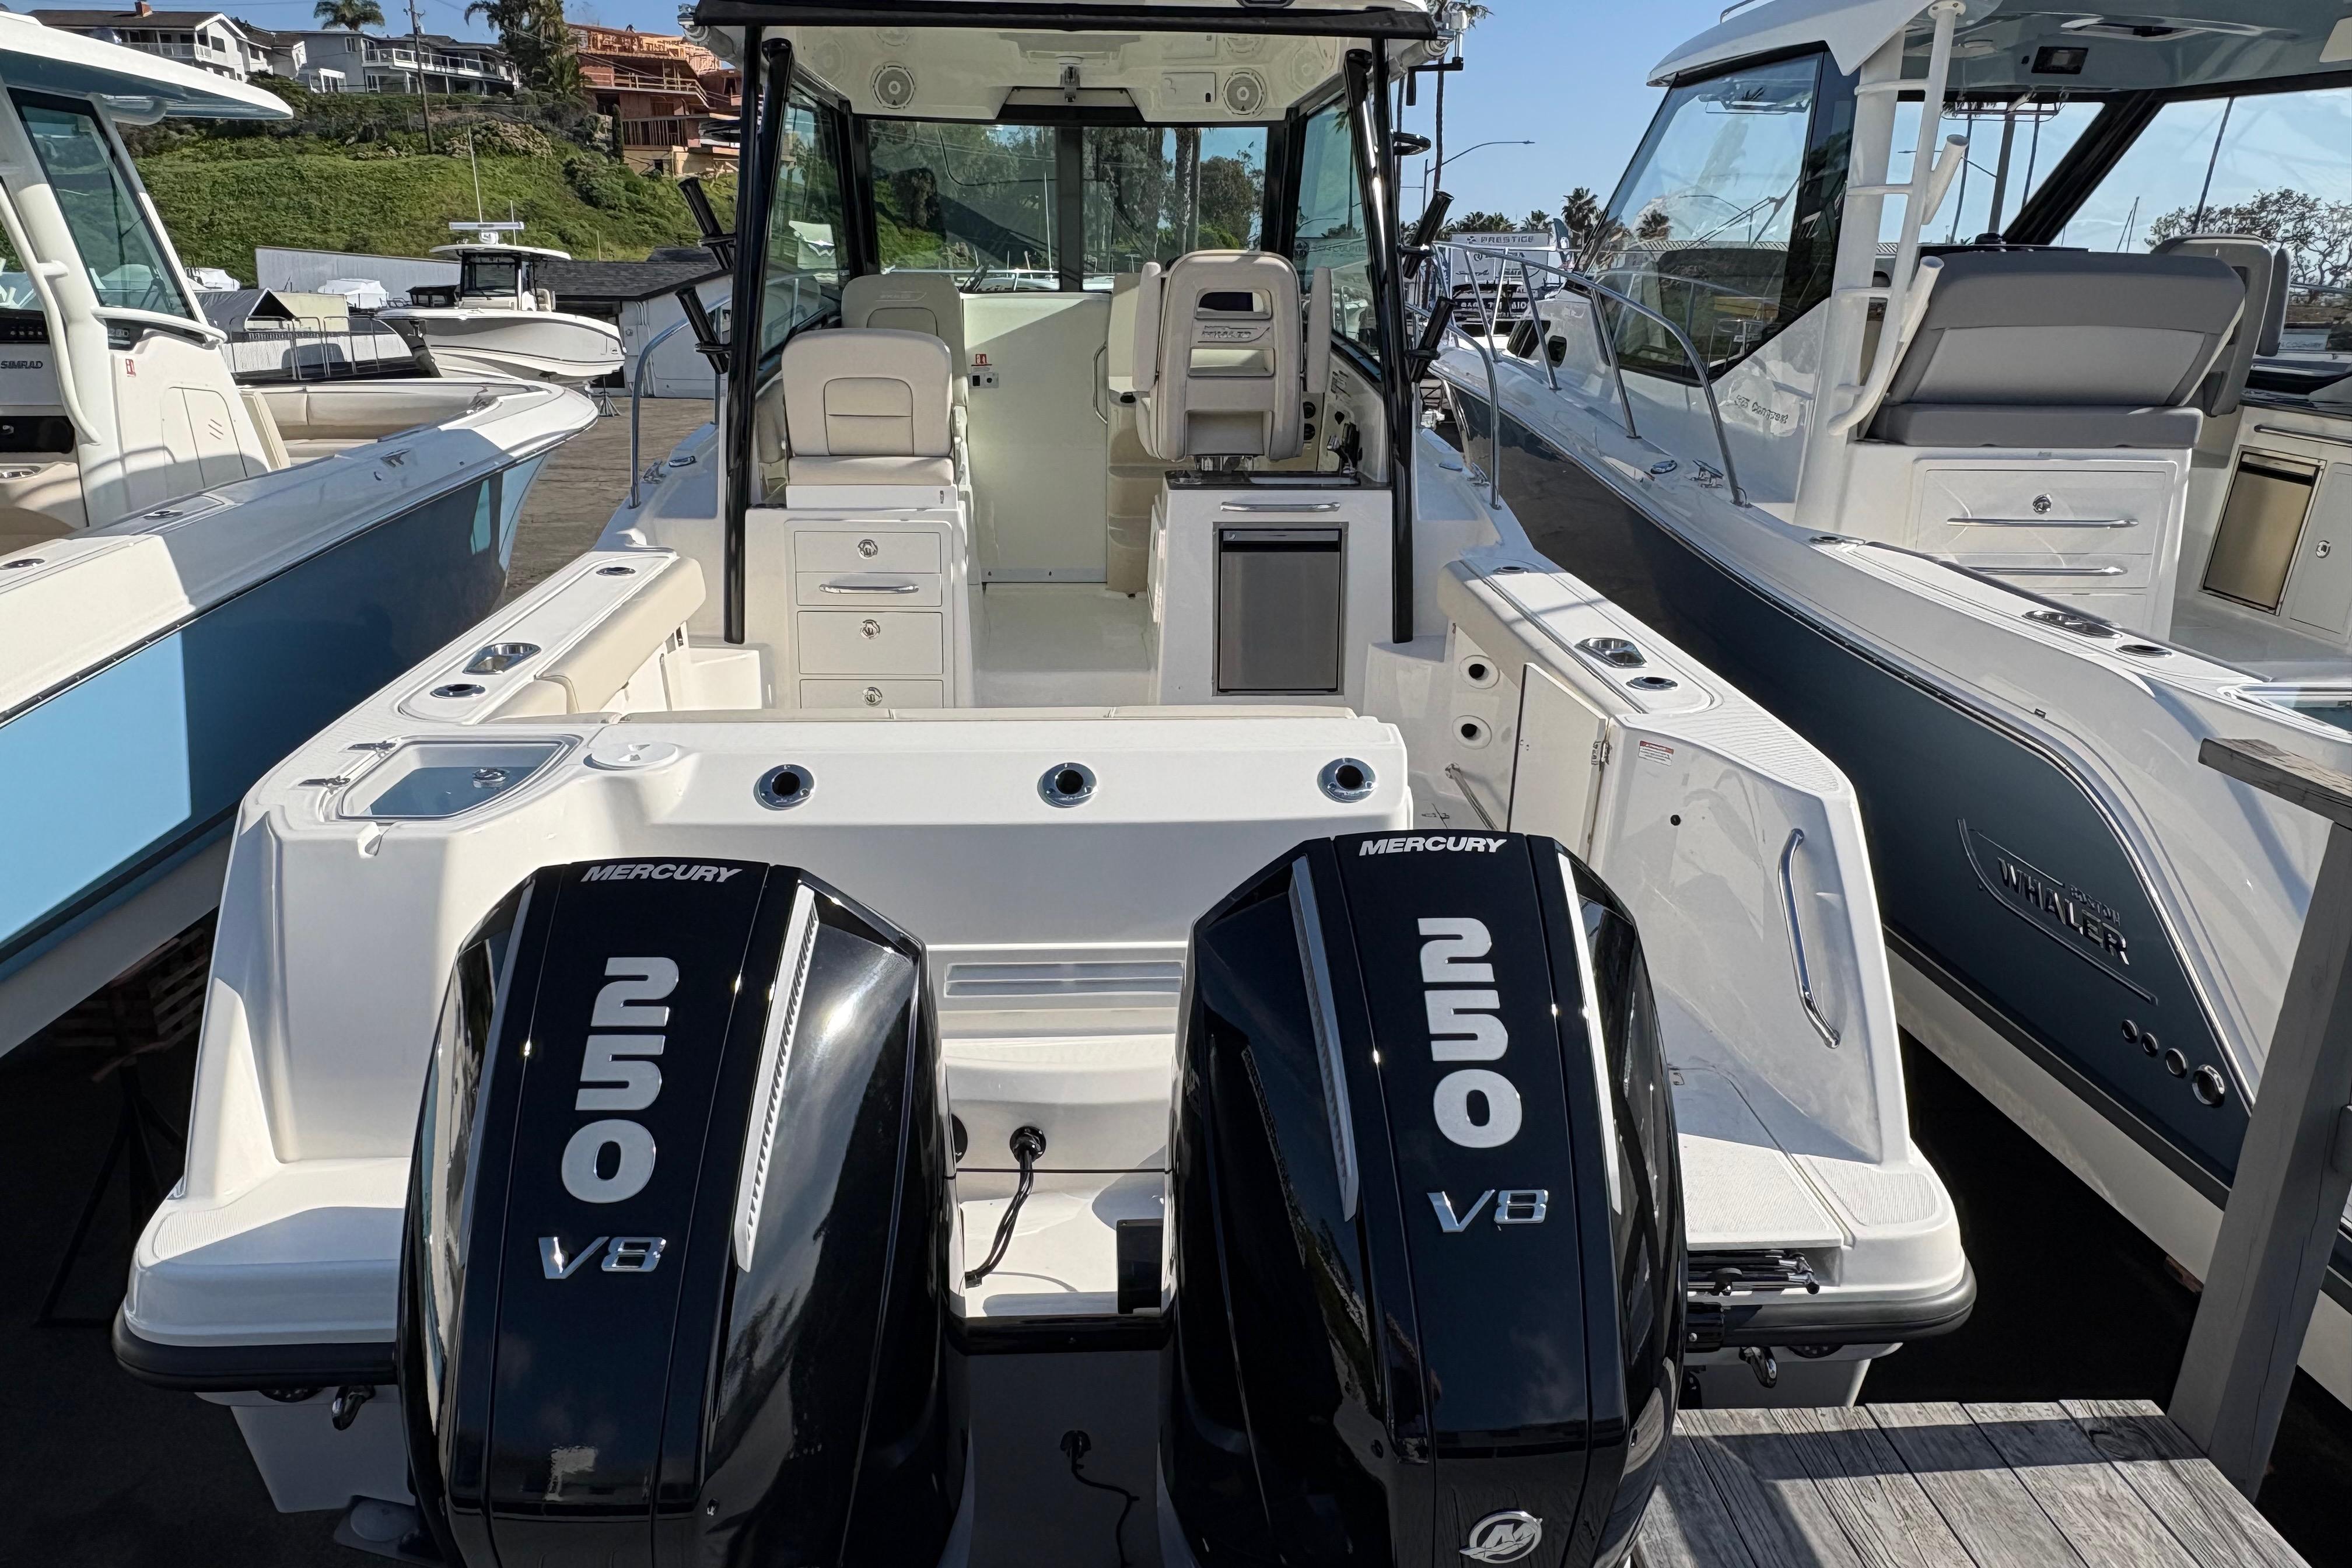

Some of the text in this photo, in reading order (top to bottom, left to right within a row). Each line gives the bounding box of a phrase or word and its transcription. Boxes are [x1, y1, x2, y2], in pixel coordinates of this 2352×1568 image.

[0, 360, 44, 370] SIMRAD
[1359, 836, 1507, 856] MERCURY
[580, 863, 743, 883] MERCURY
[1997, 855, 2130, 966] WHALER
[1417, 917, 1522, 1149] 250
[561, 956, 680, 1204] 250
[1426, 1188, 1549, 1233] V8
[538, 1236, 667, 1279] V8
